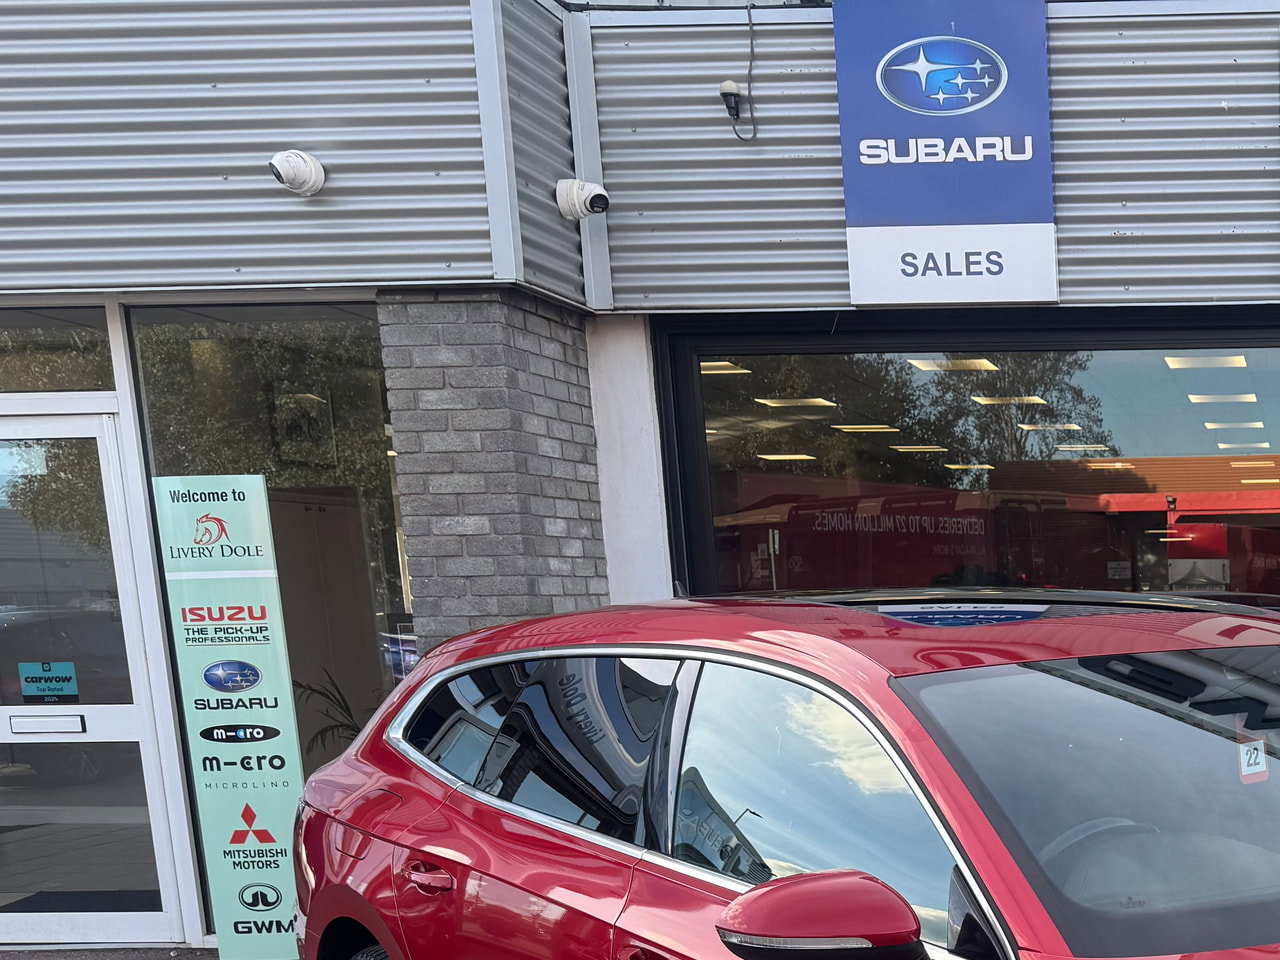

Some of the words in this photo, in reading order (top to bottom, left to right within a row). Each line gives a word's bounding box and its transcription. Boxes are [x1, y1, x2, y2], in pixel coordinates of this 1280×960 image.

[859, 135, 1034, 165] SUBARU
[900, 250, 1005, 278] SALES
[169, 489, 228, 504] Welcome
[231, 488, 246, 502] to
[169, 545, 215, 559] LIVERY
[220, 544, 264, 558] DOLE
[181, 605, 268, 623] ISUZU
[184, 627, 209, 636] THE
[214, 626, 269, 635] PICK-UP
[185, 635, 271, 644] PROFESSIONALS
[24, 676, 73, 684] carwow
[194, 697, 279, 710] SUBARU
[1245, 746, 1261, 768] 22
[204, 780, 290, 790] MICROLINO
[223, 848, 288, 860] MITSUBISHI
[232, 860, 280, 871] MOTORS
[233, 919, 295, 935] GWM
